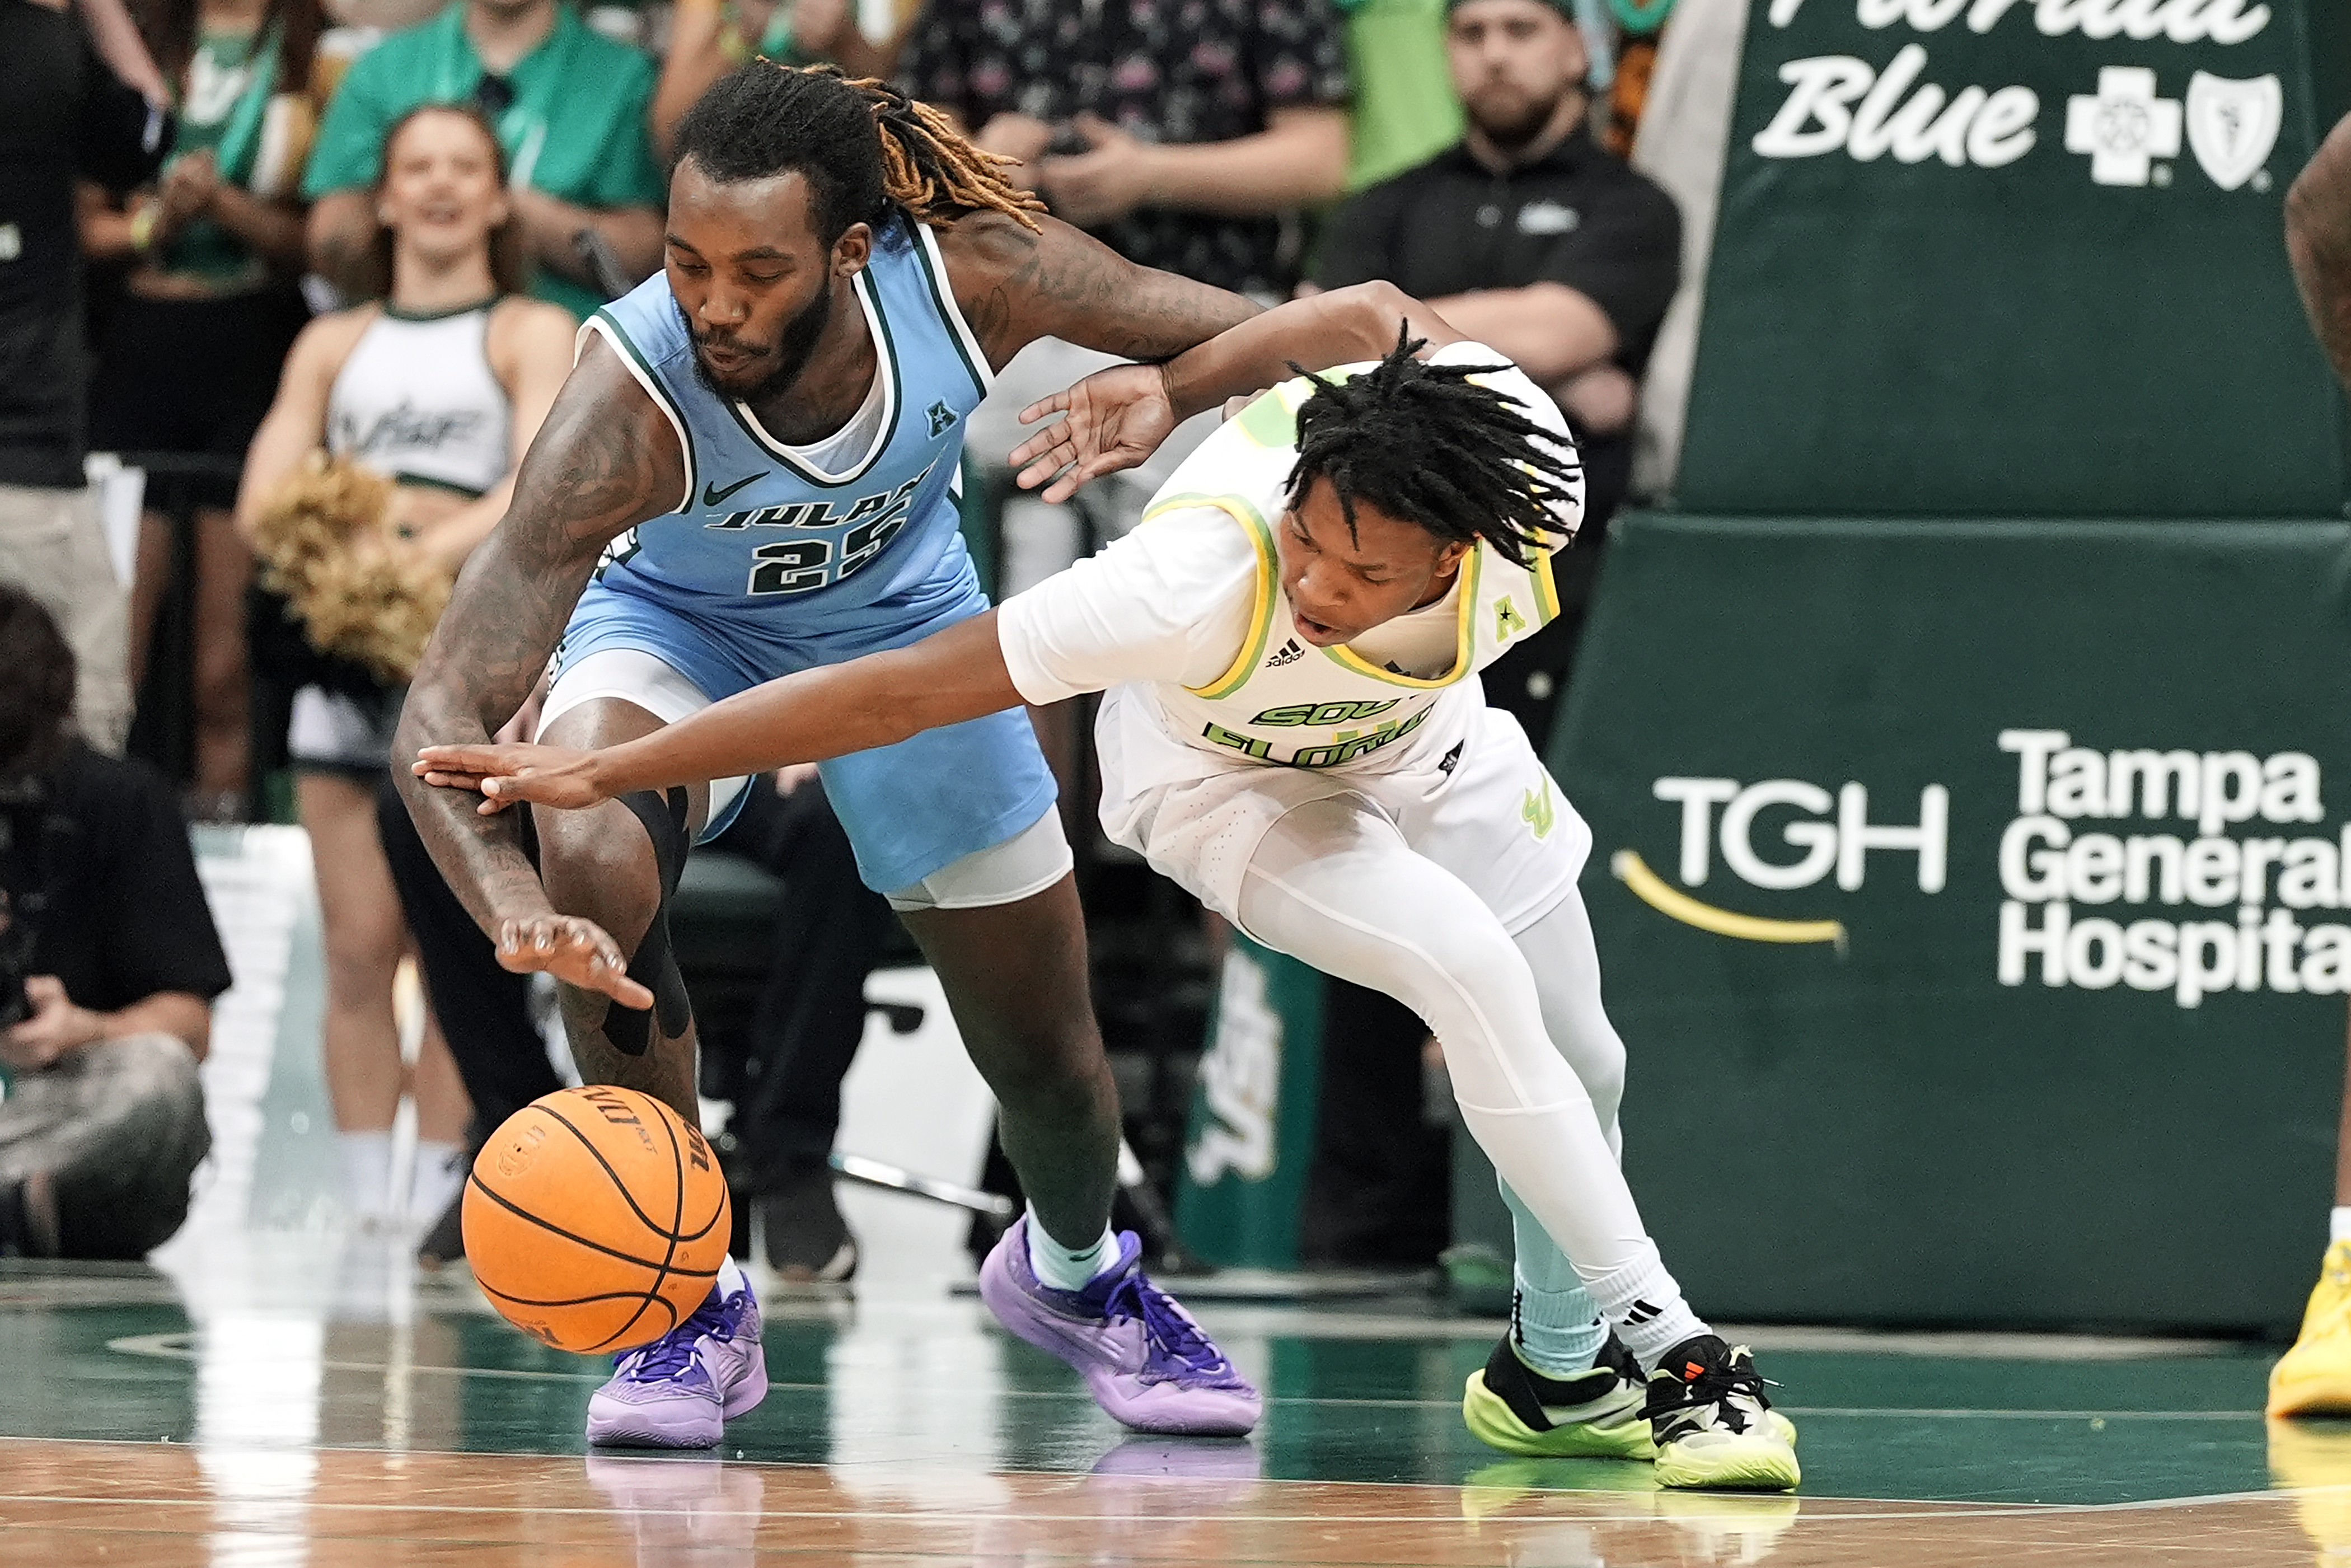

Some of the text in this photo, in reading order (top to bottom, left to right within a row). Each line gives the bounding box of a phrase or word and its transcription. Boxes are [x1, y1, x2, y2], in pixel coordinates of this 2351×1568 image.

[1752, 43, 2039, 167] Blue
[747, 495, 911, 597] 25
[1247, 694, 1420, 727] SOU
[1997, 728, 2325, 836] Tampa
[1652, 778, 1950, 895] TGH
[1998, 899, 2351, 1008] Hospita
